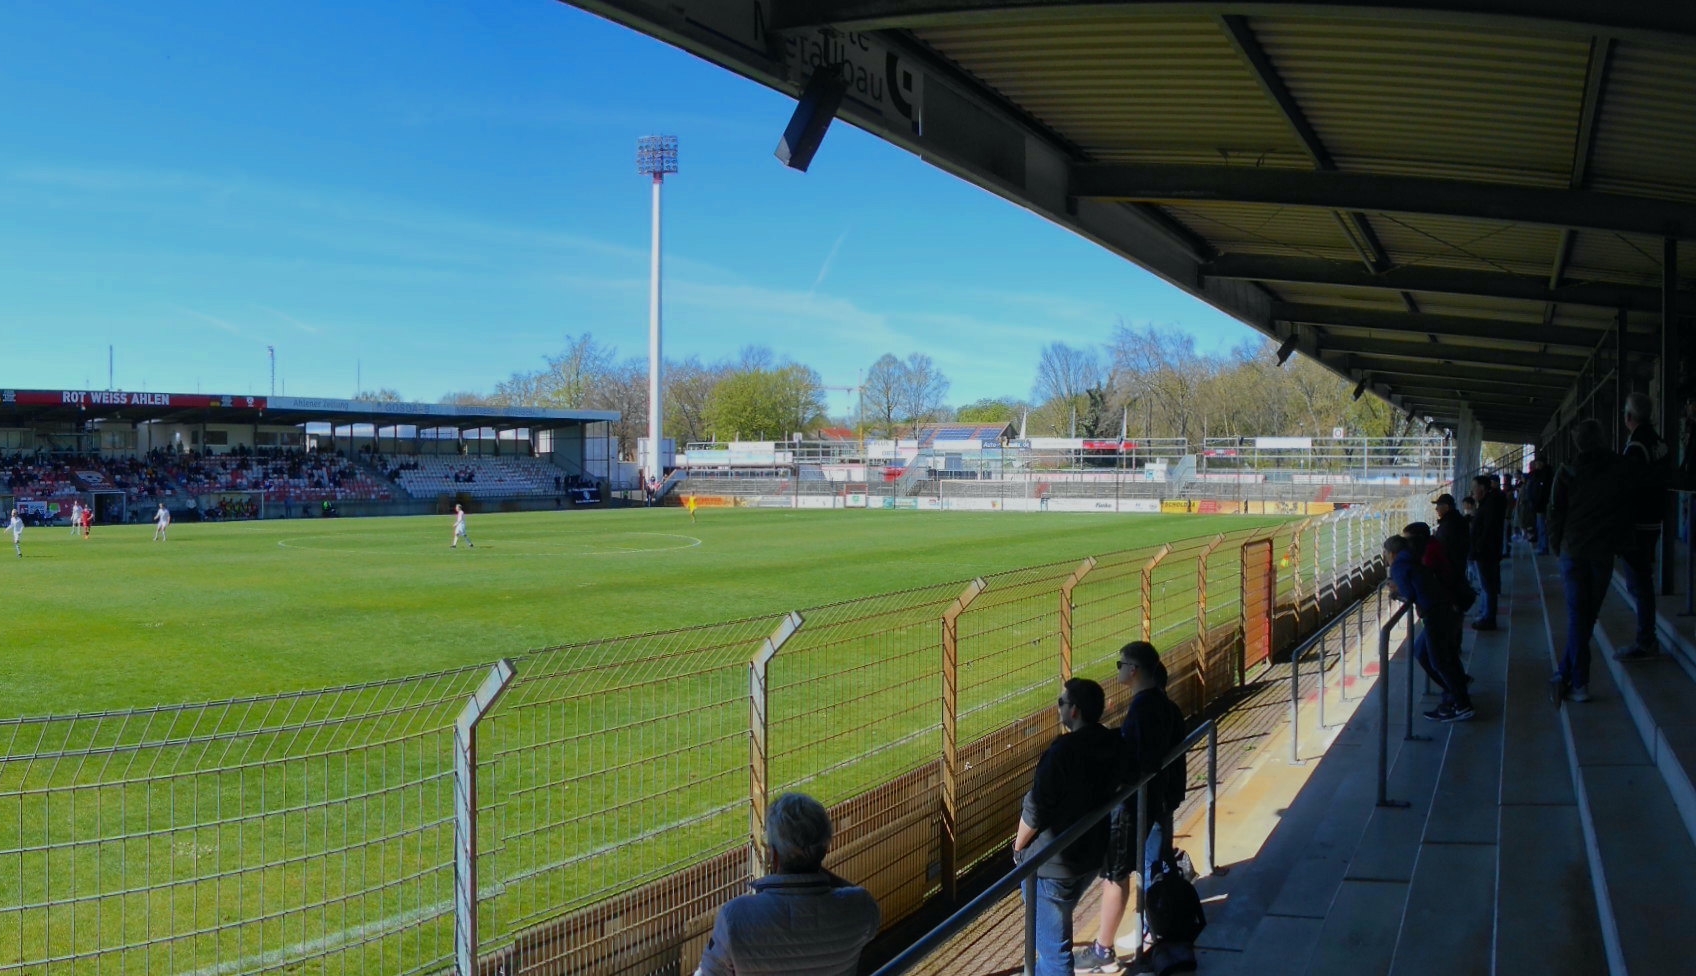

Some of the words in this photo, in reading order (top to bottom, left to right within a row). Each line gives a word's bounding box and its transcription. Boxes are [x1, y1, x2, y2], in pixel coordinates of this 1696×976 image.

[62, 391, 87, 403] ROT
[90, 392, 128, 404] WEISS
[131, 393, 170, 405] AHLEN
